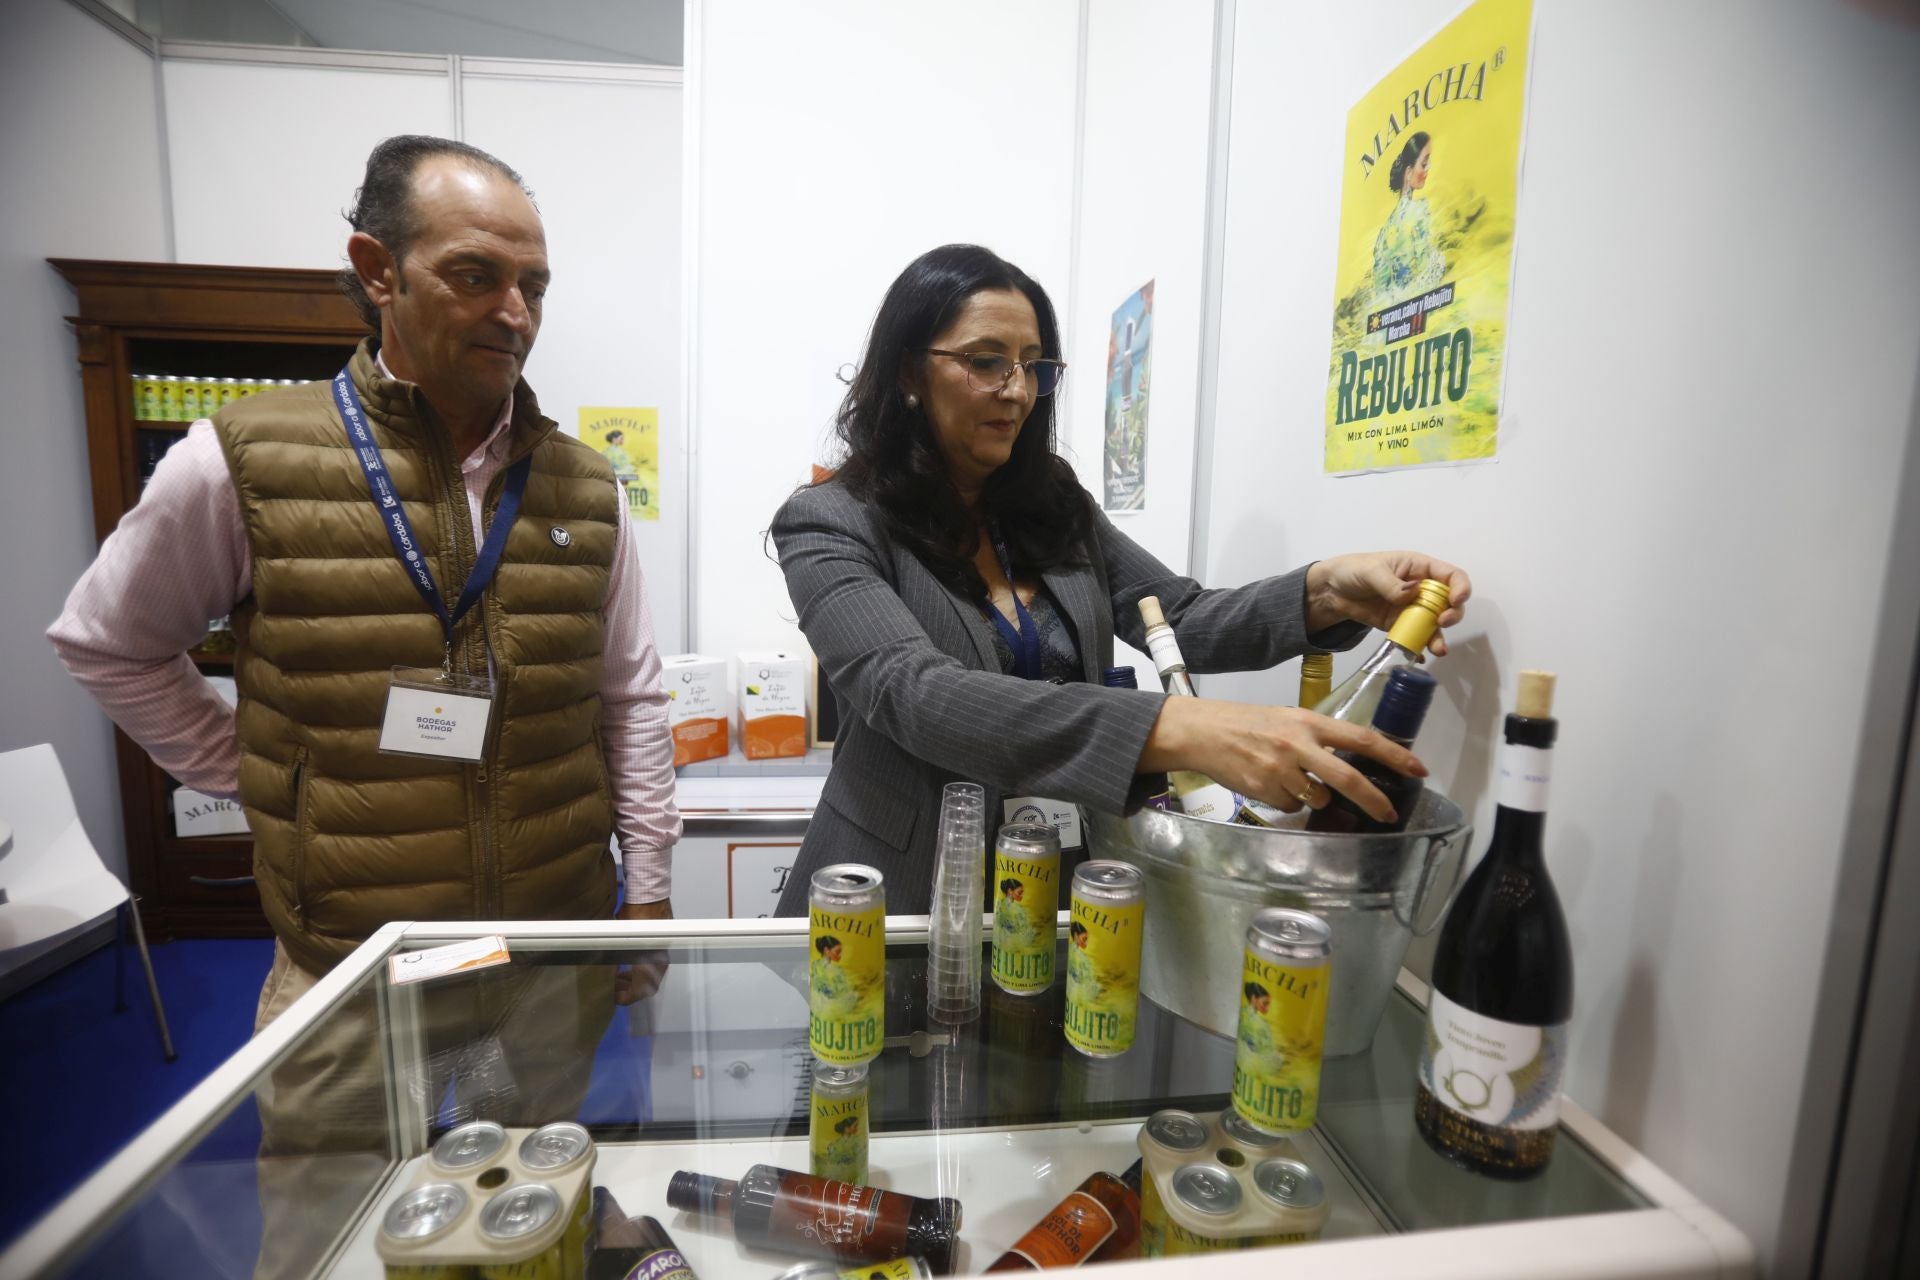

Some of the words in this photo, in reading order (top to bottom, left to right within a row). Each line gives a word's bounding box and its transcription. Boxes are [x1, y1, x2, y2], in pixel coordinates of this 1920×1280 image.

[1359, 60, 1488, 181] MARCHA
[1423, 287, 1453, 312] Rebujito
[1388, 322, 1411, 341] Marcha
[1336, 327, 1473, 425] REBUJITO
[1364, 427, 1383, 439] CON
[1385, 423, 1408, 436] LIMA
[1411, 416, 1444, 432] LIMÓN
[1387, 437, 1409, 450] VINO
[416, 716, 457, 727] BODEGAS
[418, 723, 453, 733] HATHOR
[1068, 1226, 1083, 1240] DE
